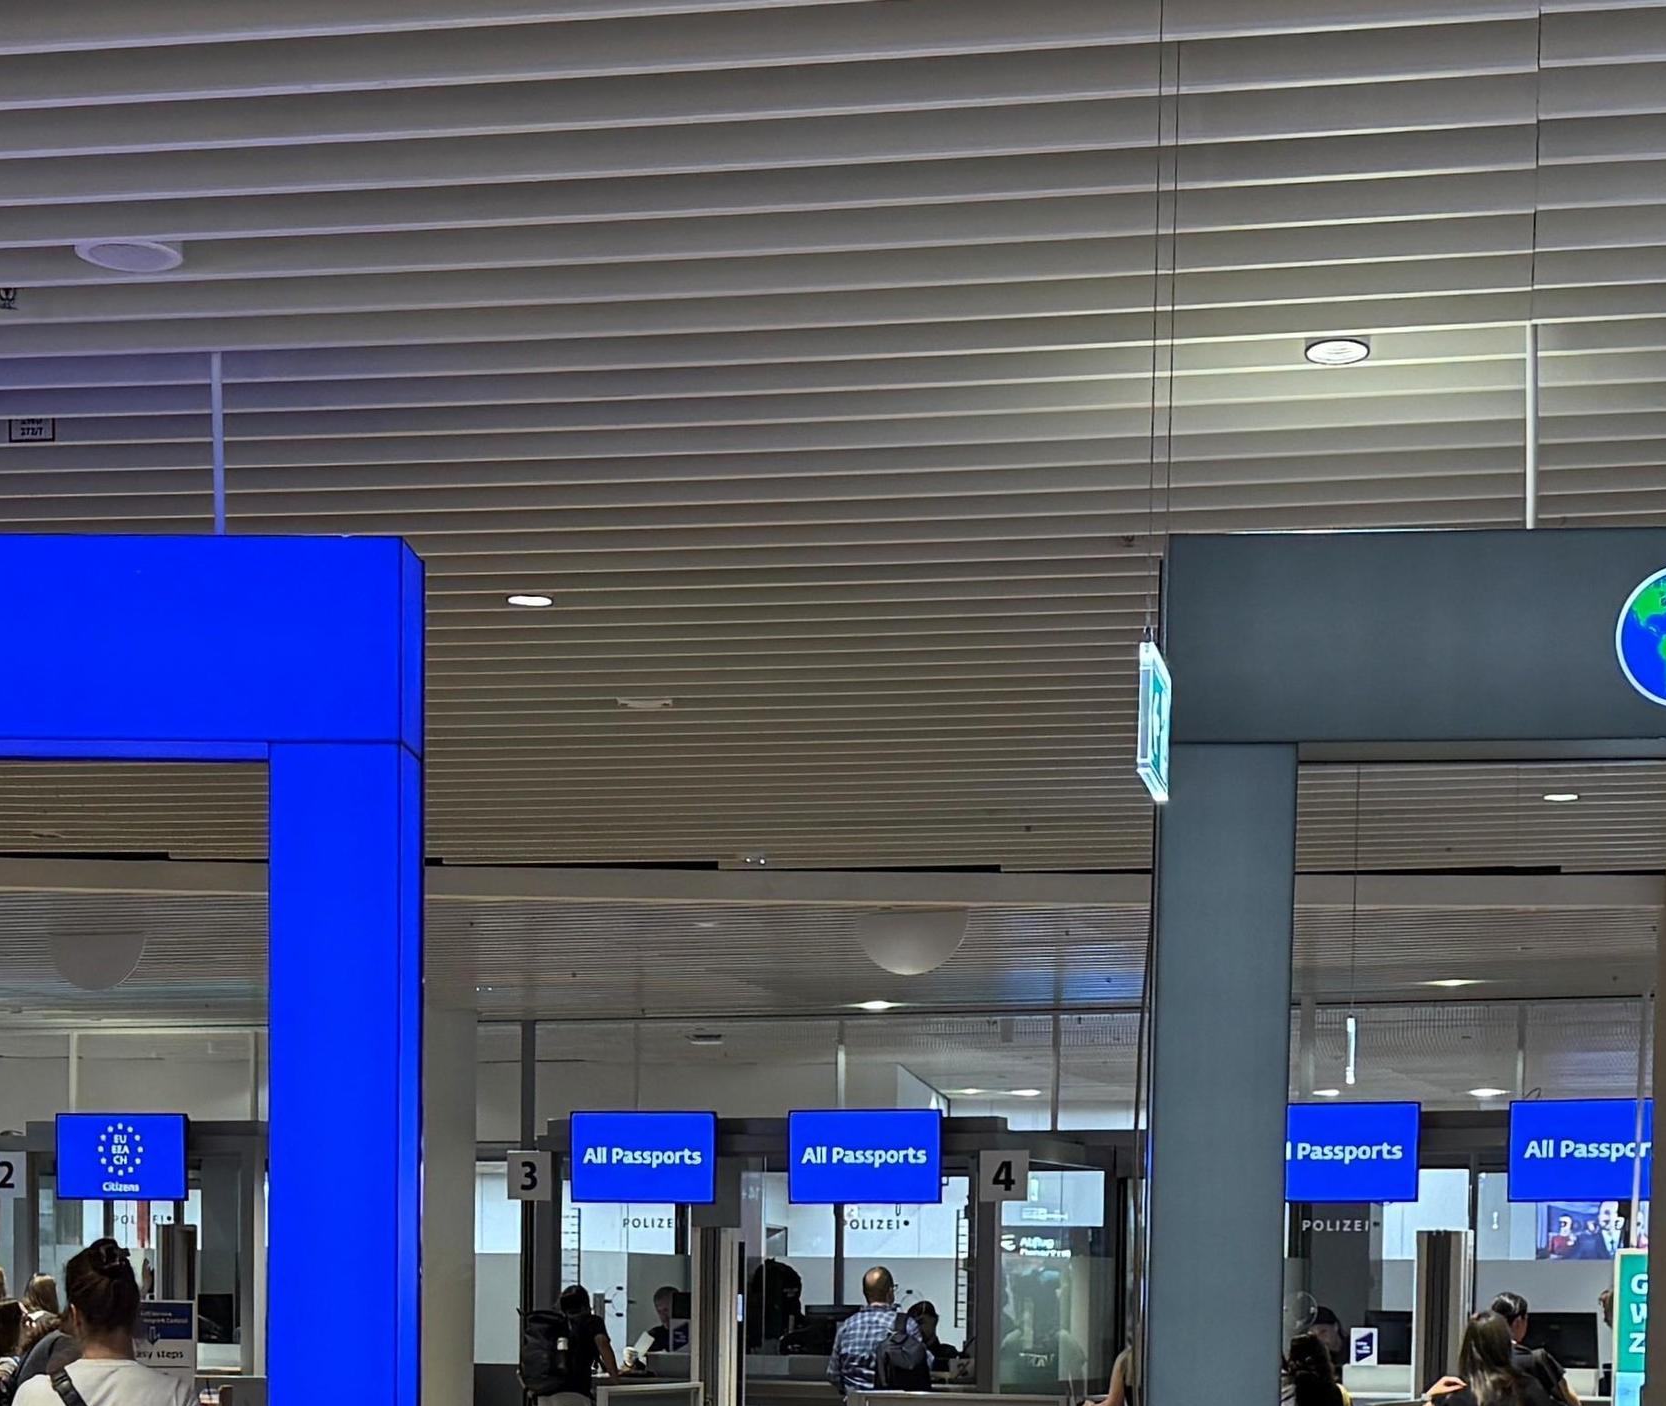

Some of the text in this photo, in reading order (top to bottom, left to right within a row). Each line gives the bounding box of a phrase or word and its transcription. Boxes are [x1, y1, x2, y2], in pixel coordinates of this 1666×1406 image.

[113, 1134, 127, 1144] EU
[1524, 1138, 1554, 1159] All
[113, 1155, 128, 1165] CH
[582, 1147, 702, 1168] All Passports
[801, 1146, 927, 1168] All Passports
[1296, 1141, 1403, 1165] Passports
[520, 1161, 538, 1191] 3
[992, 1160, 1016, 1192] 4
[102, 1182, 140, 1192] Citizens
[1301, 1219, 1370, 1231] POLIZEI
